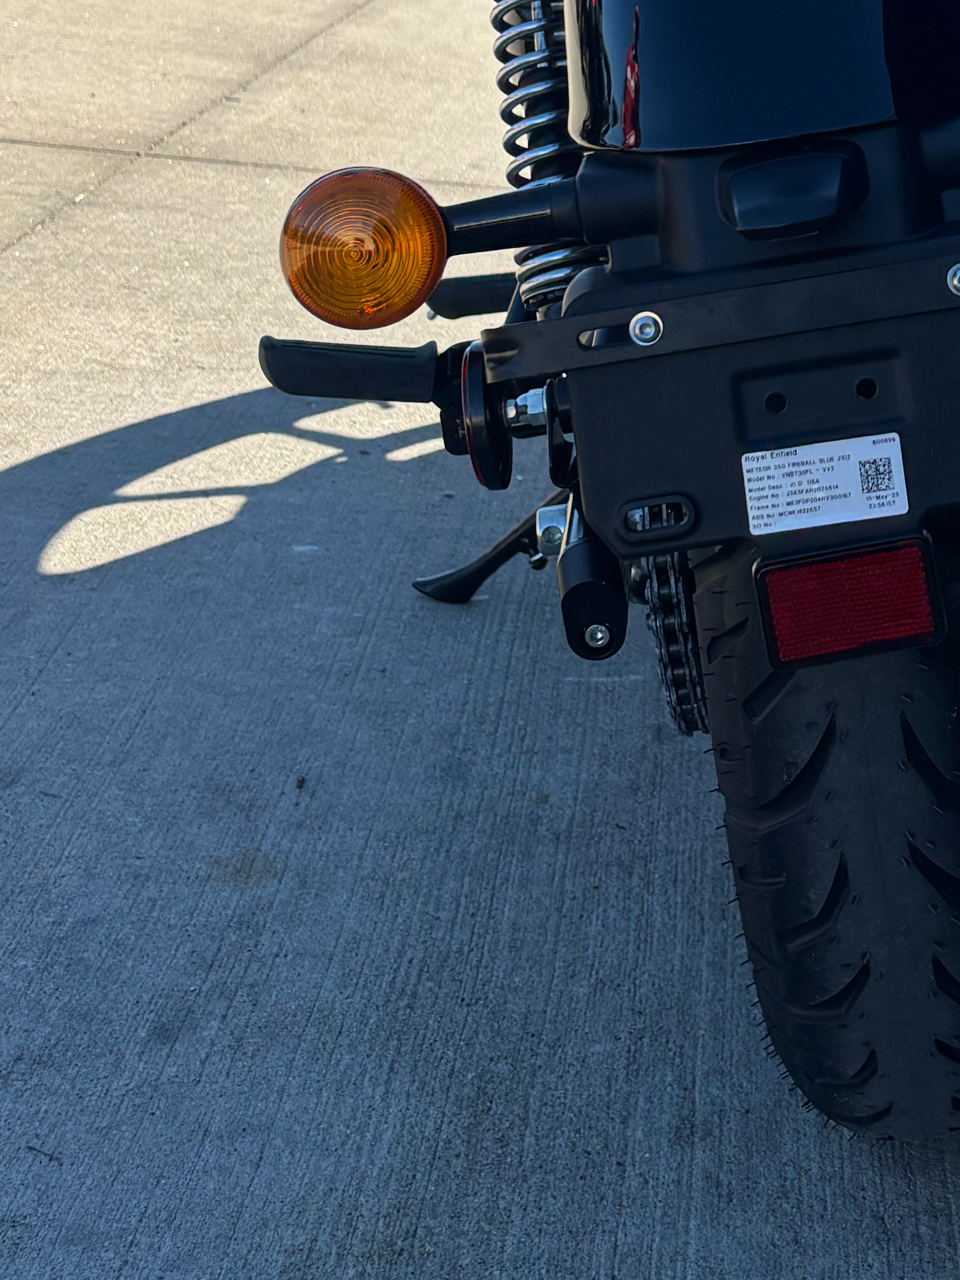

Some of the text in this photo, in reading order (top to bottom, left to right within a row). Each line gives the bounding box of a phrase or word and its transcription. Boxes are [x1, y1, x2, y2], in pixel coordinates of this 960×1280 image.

[745, 449, 798, 464] Royal Enfield
[746, 466, 771, 474] METEOR
[788, 459, 817, 469] FIREBALL
[768, 483, 783, 491] Desc
[749, 494, 769, 503] Engine
[750, 503, 769, 511] Frame
